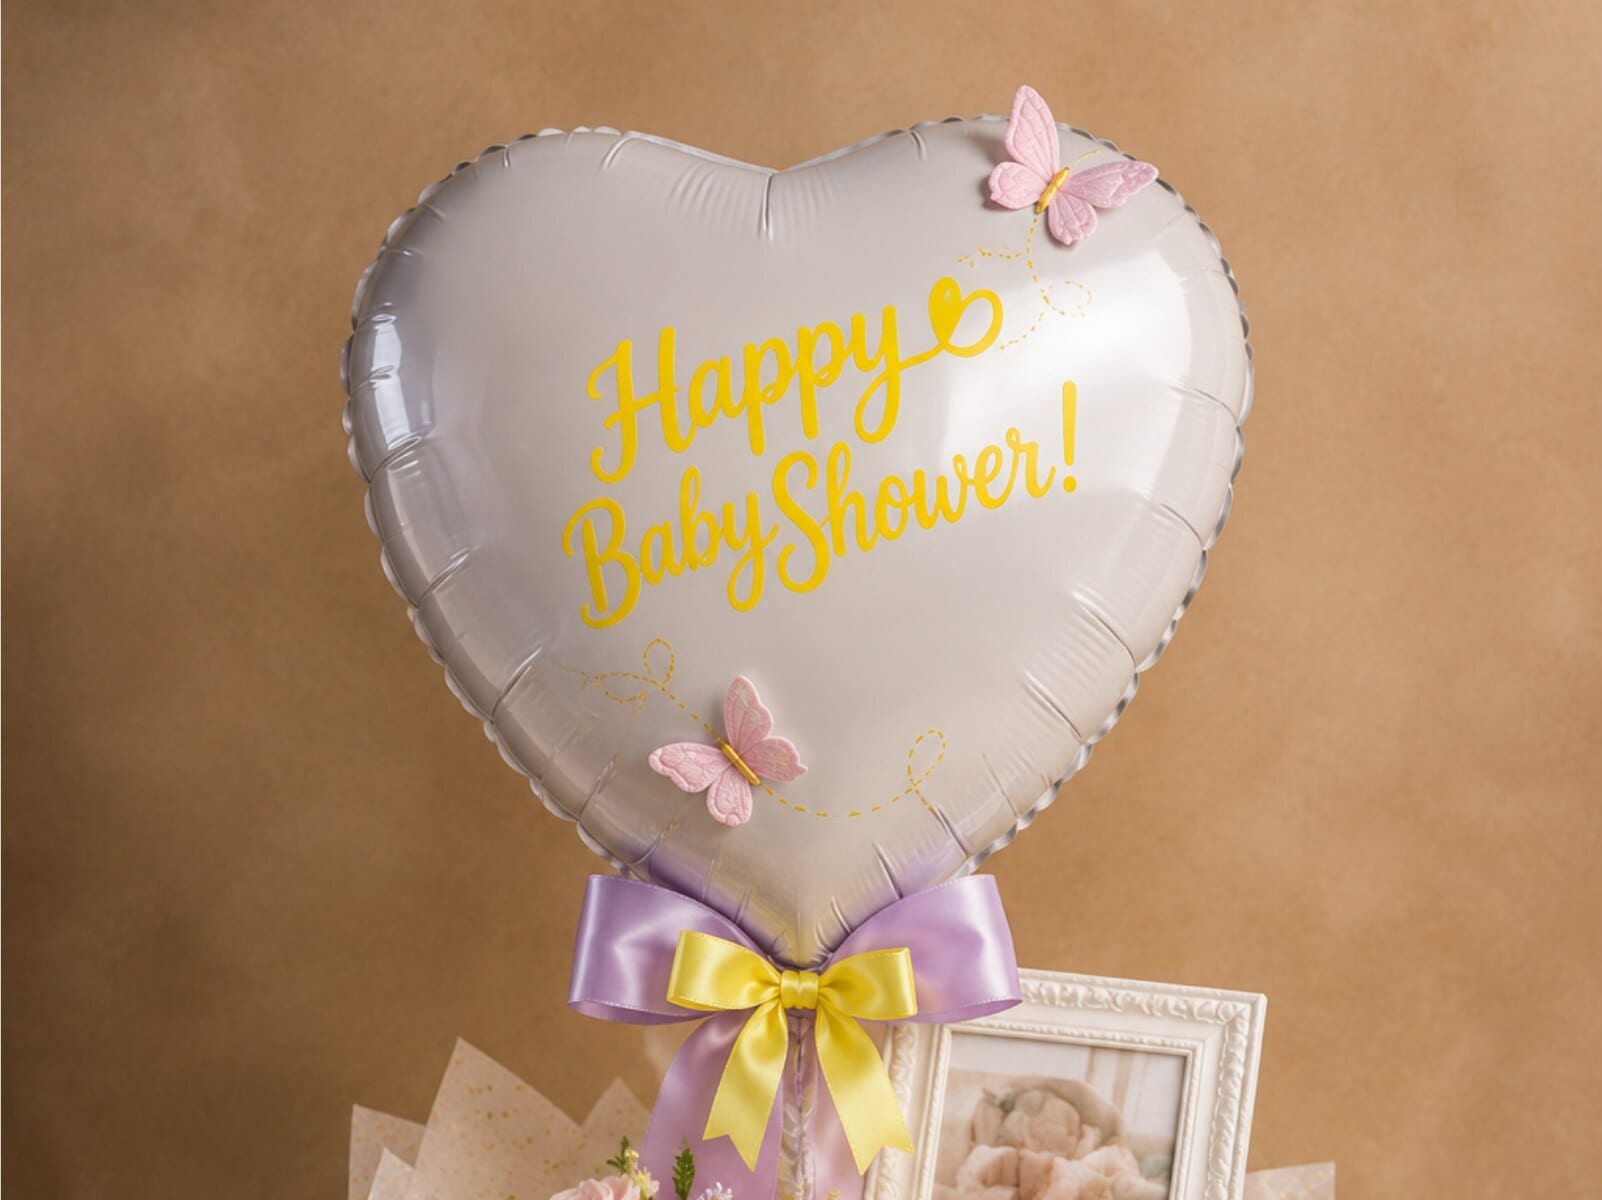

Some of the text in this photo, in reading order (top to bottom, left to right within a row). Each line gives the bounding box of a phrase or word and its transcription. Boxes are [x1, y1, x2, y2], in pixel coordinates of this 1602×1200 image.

[586, 304, 902, 484] Happy
[561, 380, 1078, 629] Baby Shower!
